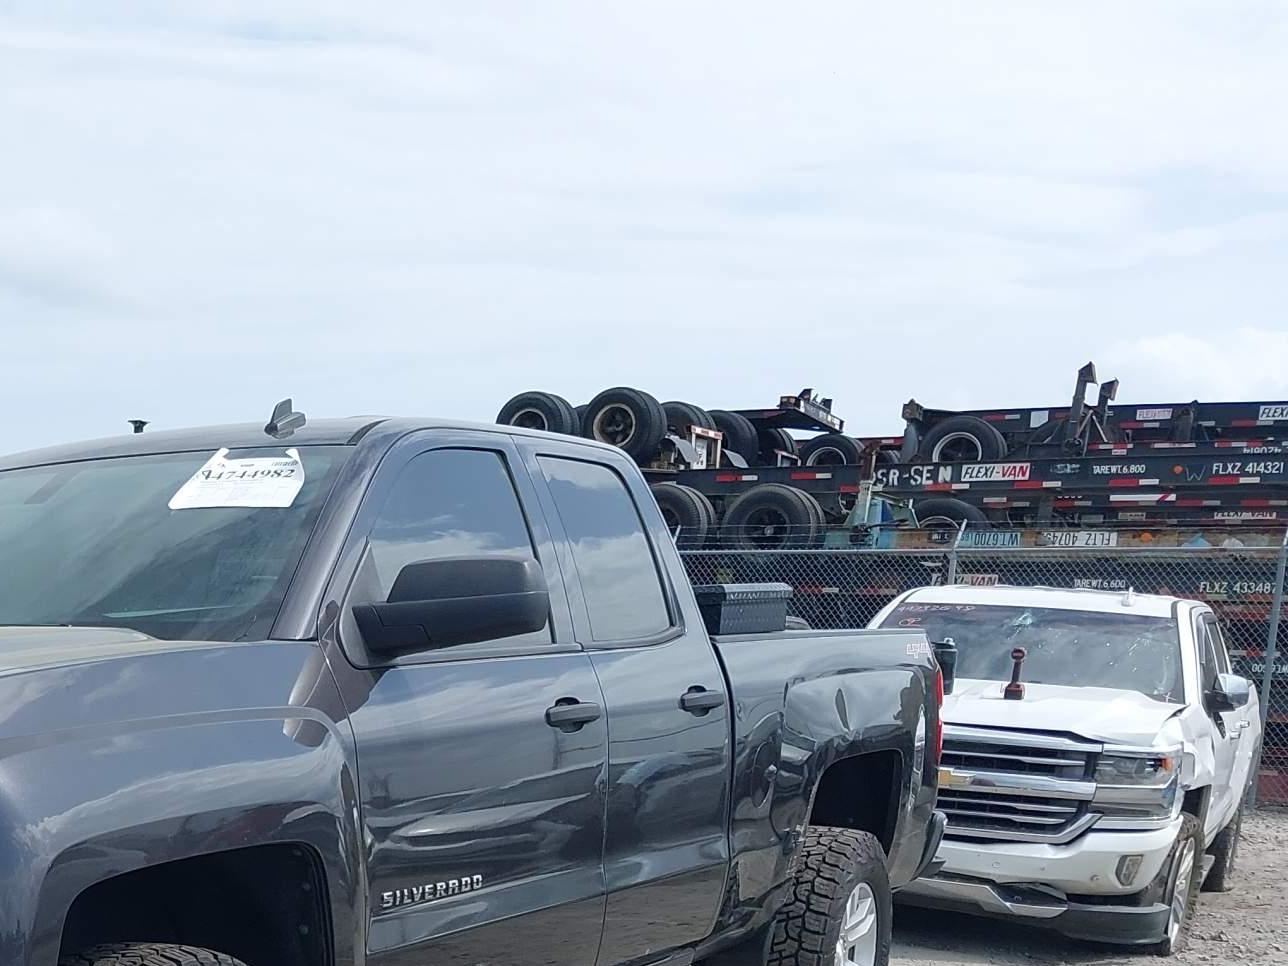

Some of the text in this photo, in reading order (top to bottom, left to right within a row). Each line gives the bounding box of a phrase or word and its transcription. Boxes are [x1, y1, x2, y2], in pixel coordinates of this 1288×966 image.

[963, 464, 1029, 479] FLEXI-VAN
[1212, 462, 1284, 475] FLXZ 414321
[1085, 533, 1111, 545] FLTZ
[1199, 581, 1228, 593] FLXZ
[381, 874, 483, 908] SILVERADO
